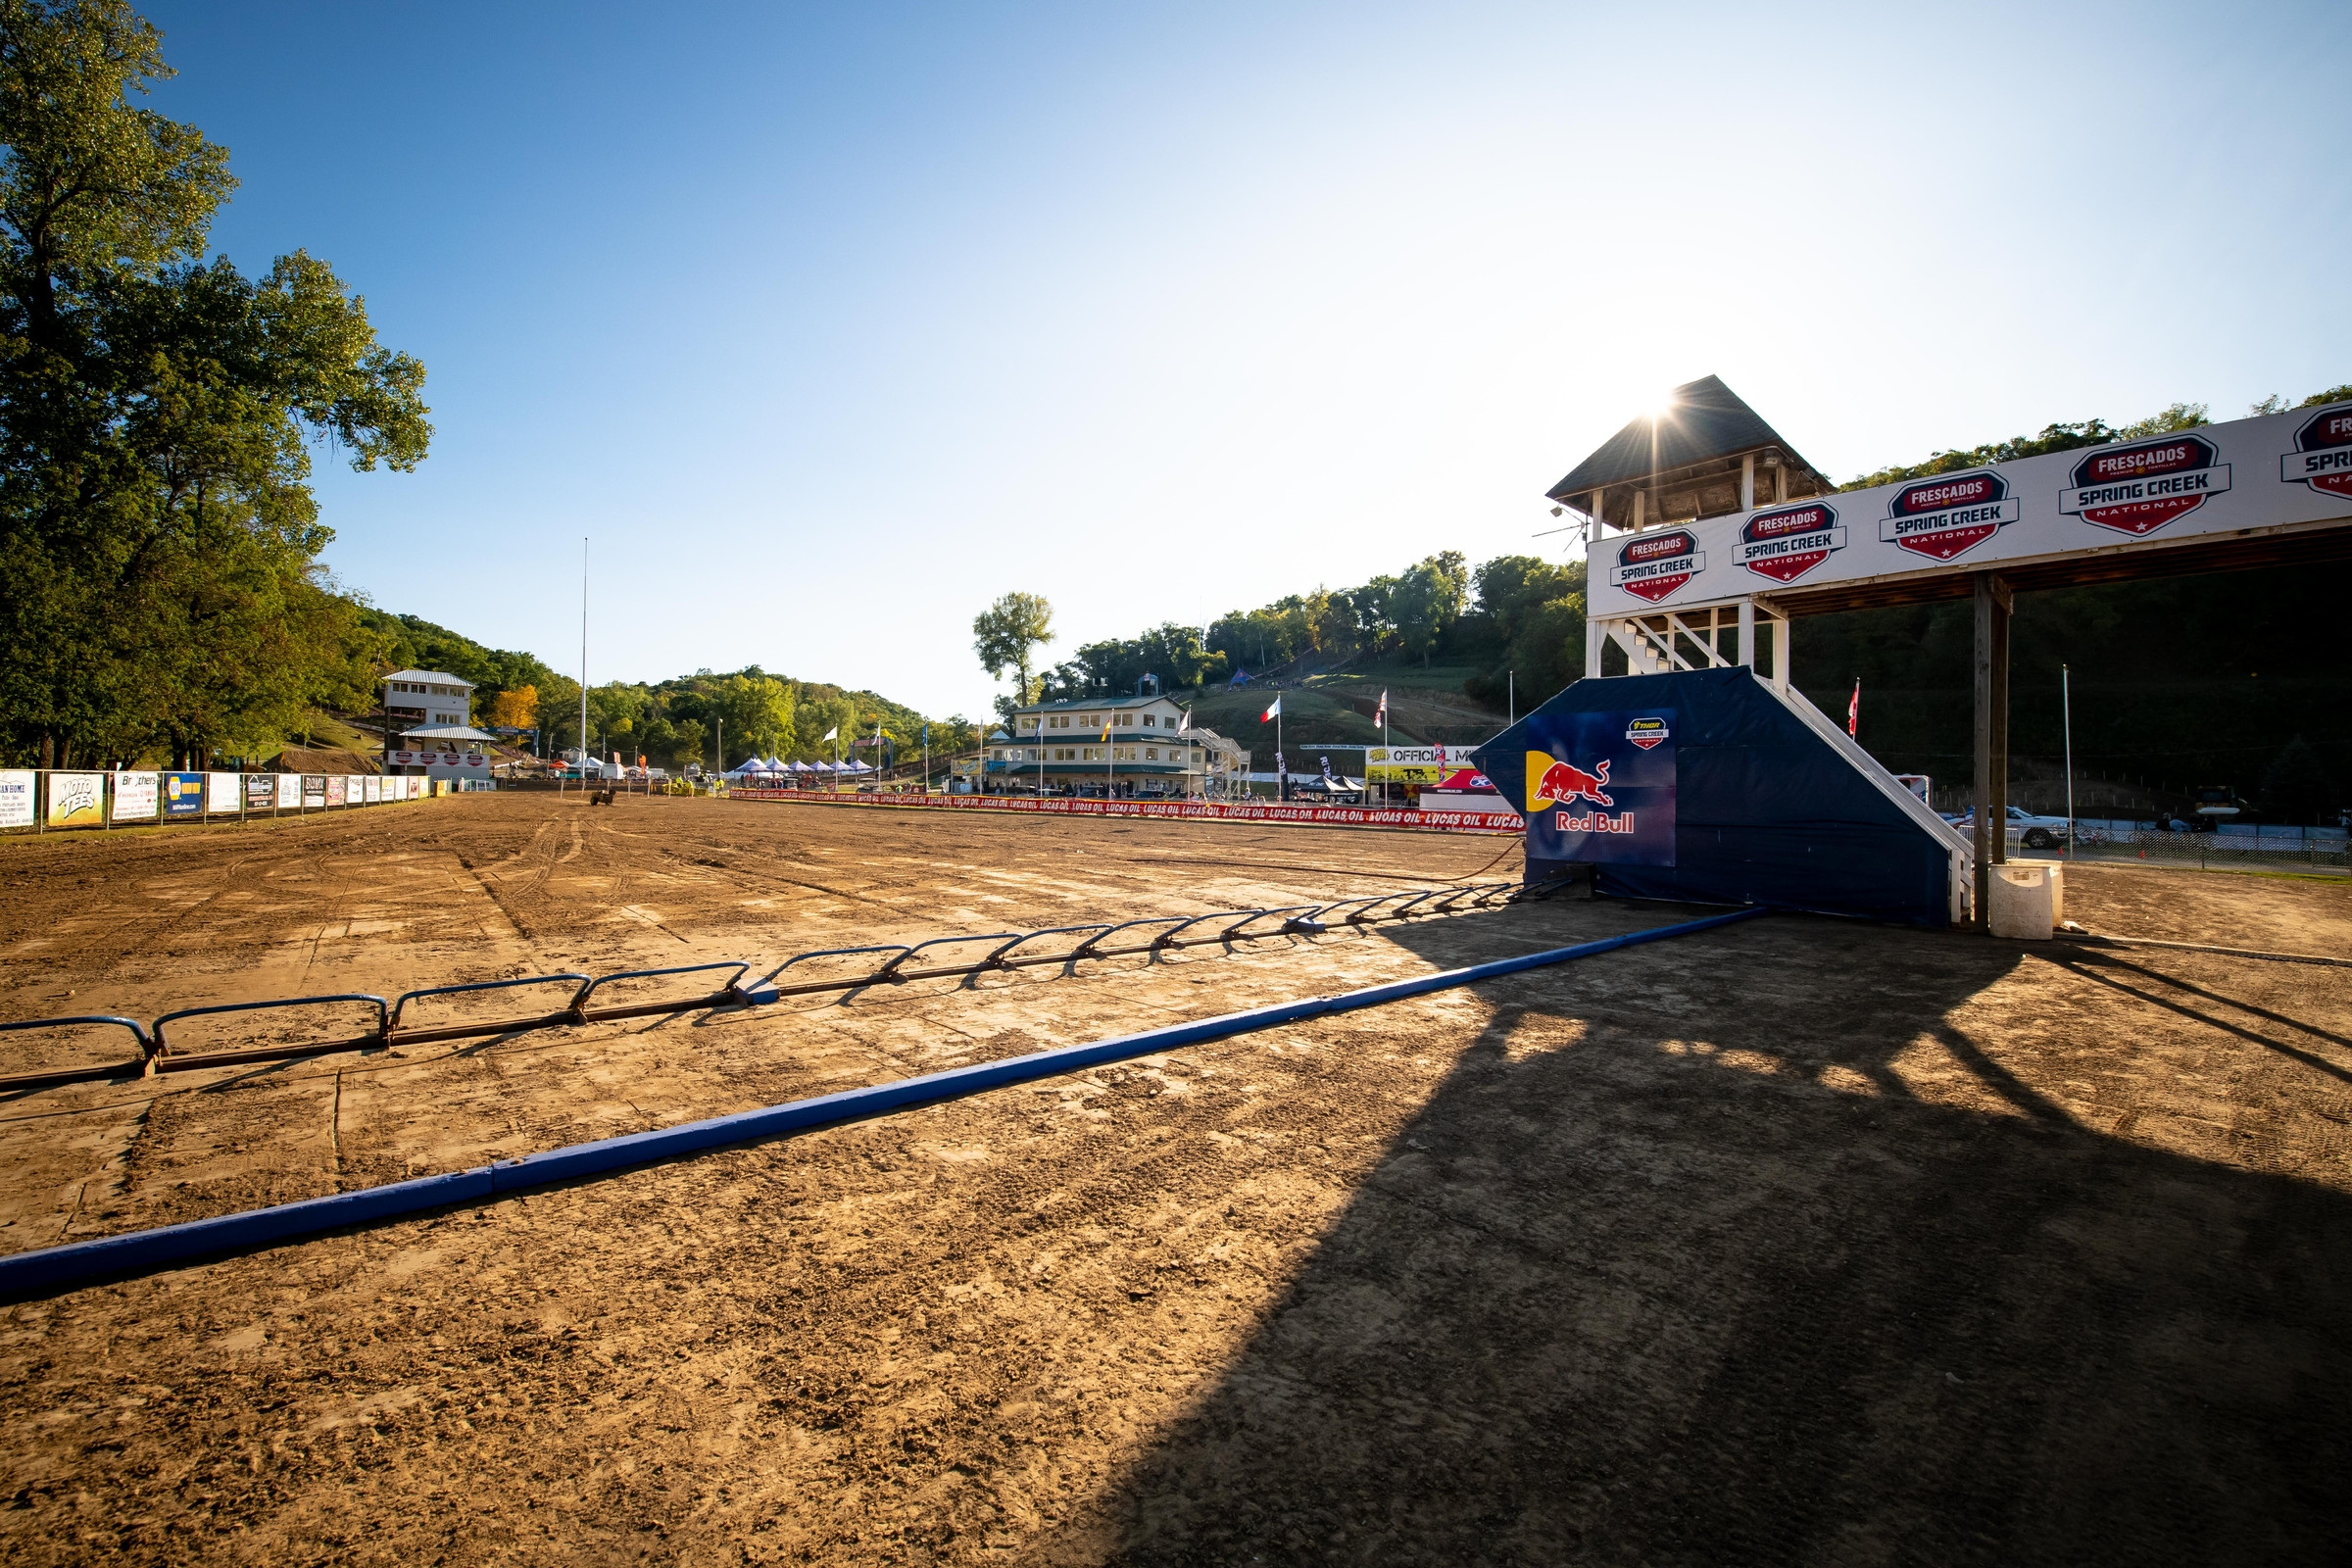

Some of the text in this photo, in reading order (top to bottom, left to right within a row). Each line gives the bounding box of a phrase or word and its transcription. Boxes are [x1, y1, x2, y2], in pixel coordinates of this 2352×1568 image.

[2098, 446, 2185, 472] FRESCADOS
[1912, 481, 1983, 505] FRESCADOS
[2079, 473, 2209, 507] SPRING CREEK
[2097, 500, 2189, 517] NATIONAL
[1758, 512, 1817, 531] FRESCADOS
[1895, 506, 2001, 534] SPRING CREEK
[1632, 538, 1681, 556] FRESCADOS
[1744, 533, 1832, 559] SPRING CREEK
[1910, 528, 1985, 544] NATIONAL
[1621, 558, 1693, 580] SPRING CREEK
[1756, 554, 1819, 567] NATIONAL
[1631, 576, 1683, 589] NATIONAL
[1394, 750, 1450, 761] OFFICIL
[59, 778, 92, 806] MOTO
[64, 792, 94, 819] TEES
[1009, 800, 1028, 808] LUCAS
[1040, 802, 1058, 810] LUCAS
[1072, 803, 1092, 811] LUCAS
[1105, 804, 1128, 813] LUCAS
[1129, 805, 1141, 813] OIL
[1144, 805, 1166, 814] LUCAS
[1167, 806, 1179, 814] OIL
[1182, 806, 1205, 816] LUCAS
[1207, 807, 1220, 816] OIL
[1223, 808, 1250, 818] LUCAS
[1252, 808, 1265, 818] OIL
[1269, 808, 1298, 819] LUCAS
[1298, 809, 1313, 819] OIL
[1317, 809, 1346, 821] LUCAS
[1348, 810, 1364, 821] OIL
[1403, 812, 1420, 823] OIL
[1425, 812, 1460, 826] LUCAS
[1463, 813, 1481, 826] OIL
[1486, 815, 1525, 828] LUCAS
[1556, 811, 1634, 833] Red Bull
